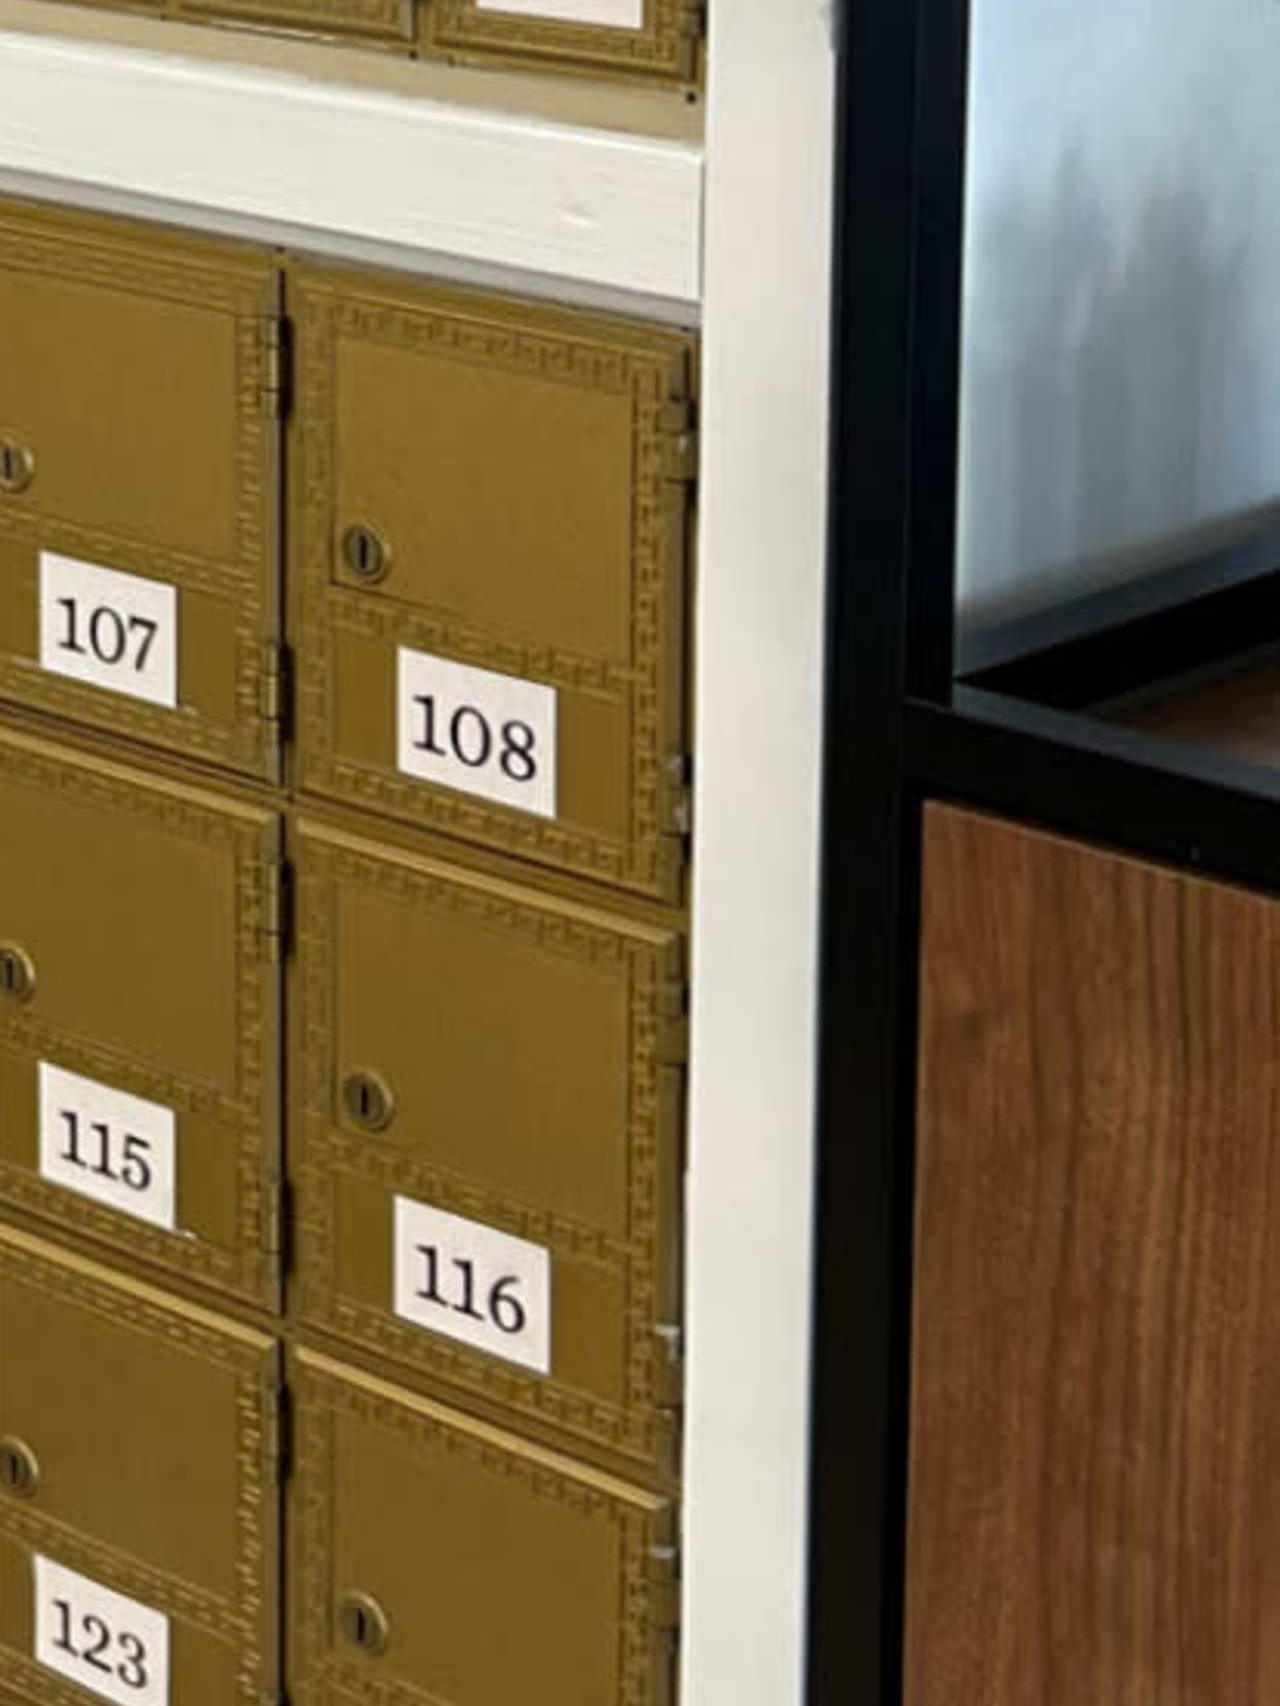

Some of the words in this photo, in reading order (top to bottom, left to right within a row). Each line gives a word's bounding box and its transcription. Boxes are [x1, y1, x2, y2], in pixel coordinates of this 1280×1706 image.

[58, 597, 158, 672] 107
[417, 695, 537, 781] 108
[60, 1110, 152, 1192] 115
[416, 1244, 526, 1334] 116
[53, 1599, 148, 1689] 123
